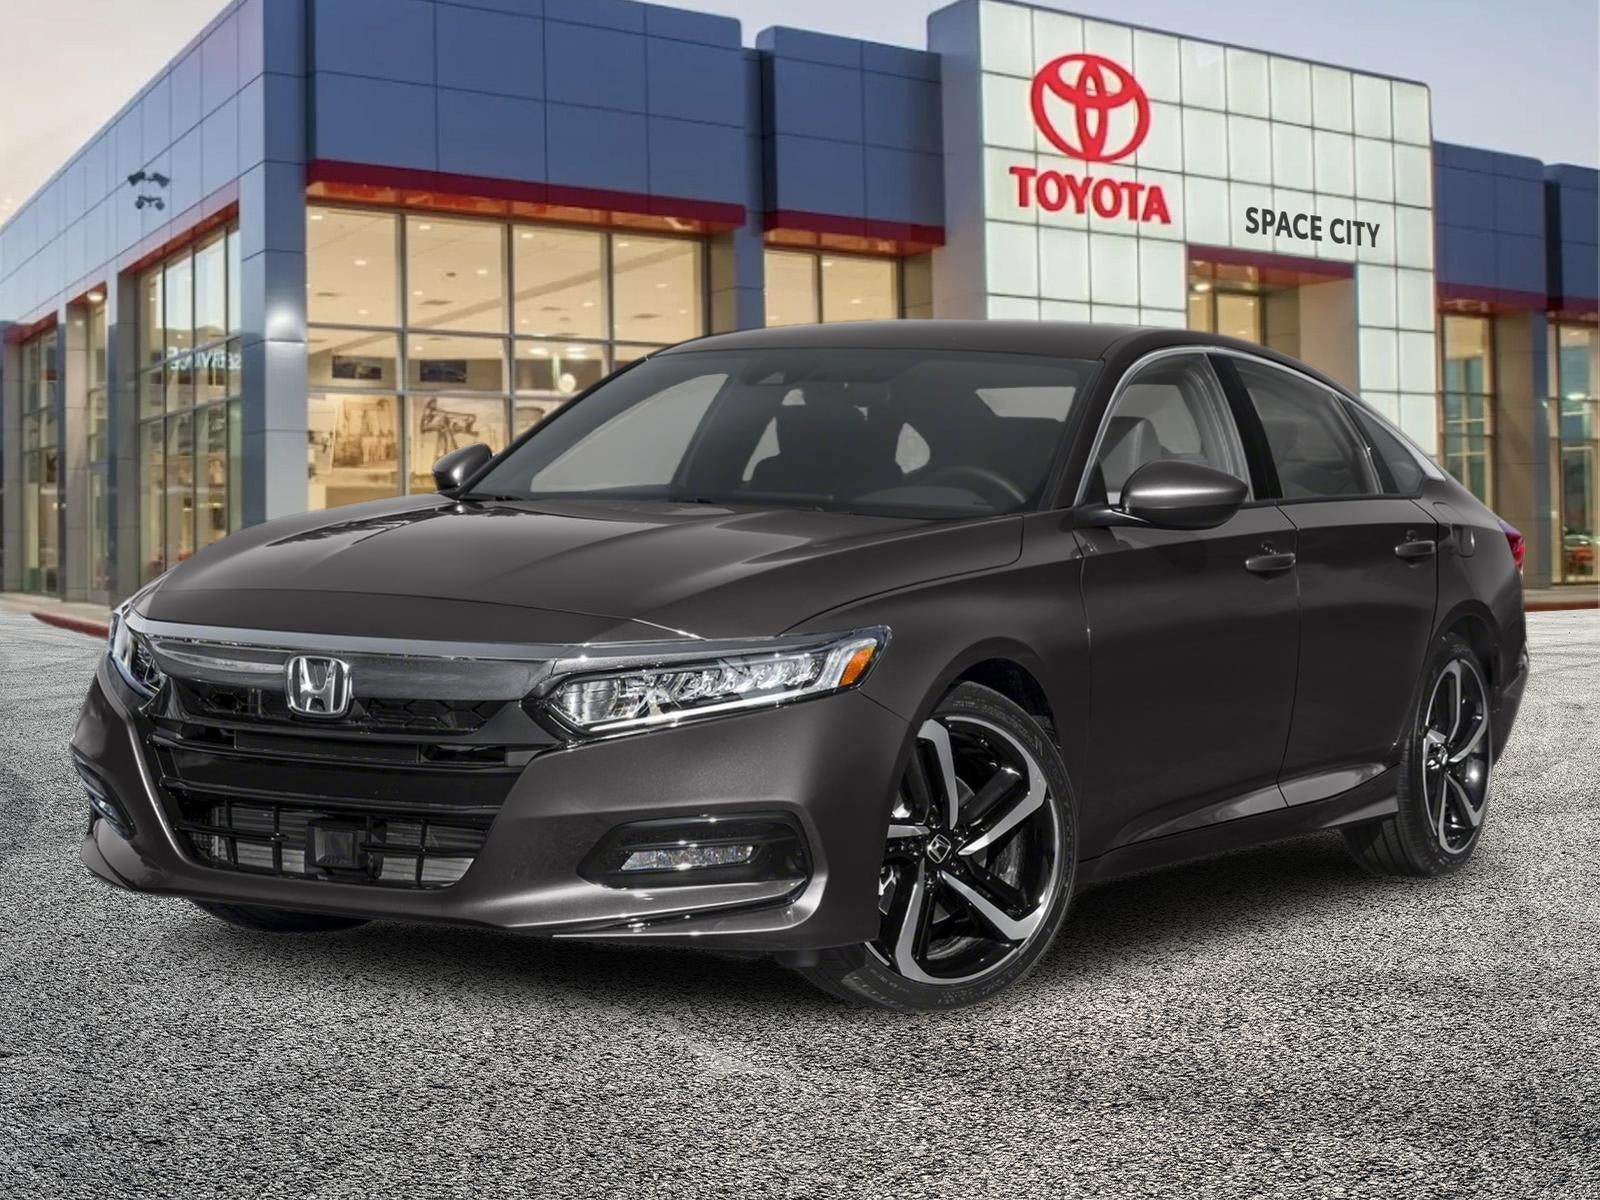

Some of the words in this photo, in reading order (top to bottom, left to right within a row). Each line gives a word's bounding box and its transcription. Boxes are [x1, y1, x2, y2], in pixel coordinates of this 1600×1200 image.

[1009, 166, 1171, 224] TOYOTA
[1245, 207, 1323, 241] SPACE
[1329, 218, 1381, 248] CITY
